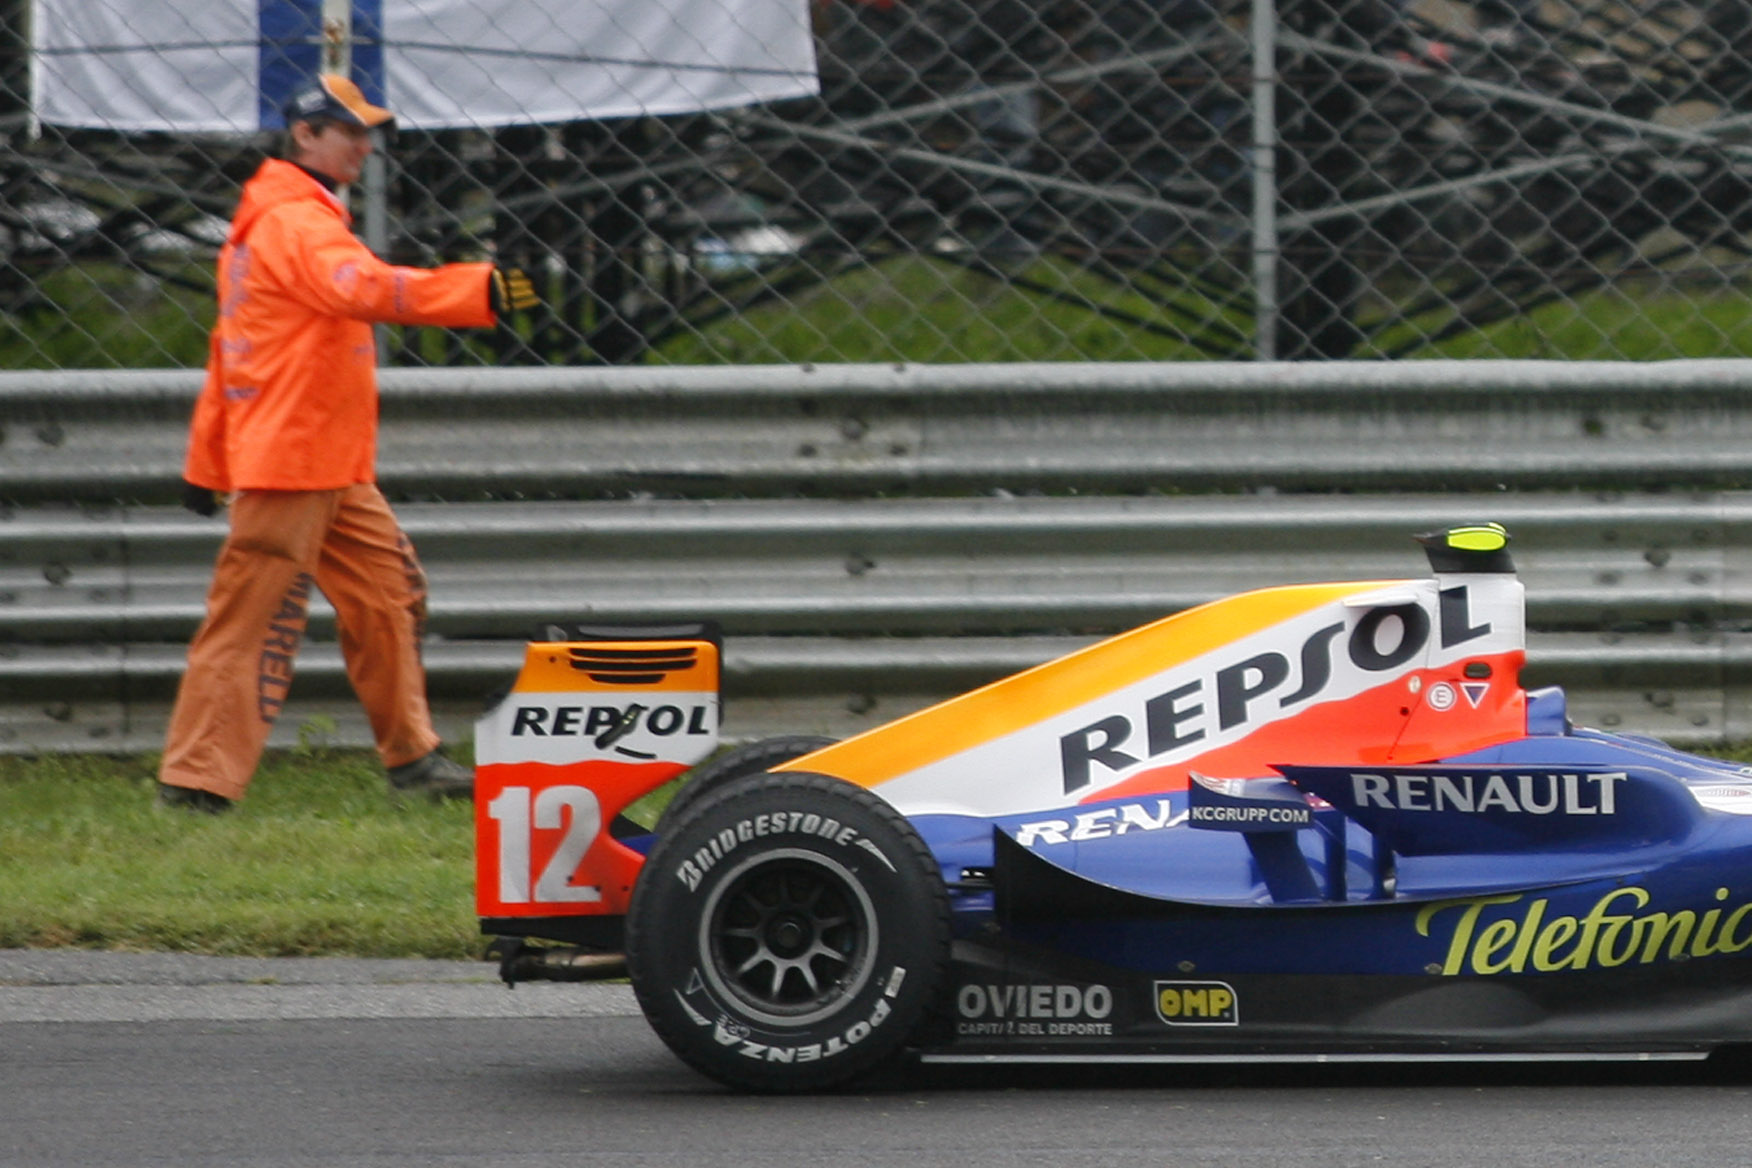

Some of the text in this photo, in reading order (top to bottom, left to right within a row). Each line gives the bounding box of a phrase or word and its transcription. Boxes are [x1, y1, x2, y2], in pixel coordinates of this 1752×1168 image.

[1060, 585, 1492, 795] REPSOL
[1350, 772, 1627, 815] RENAULT
[488, 785, 602, 904] 12
[676, 812, 859, 892] BRIDGESTONE
[958, 985, 1113, 1018] OVIEDO
[1159, 988, 1232, 1017] OMP
[713, 998, 892, 1064] POTENZA
[1018, 1022, 1045, 1036] DEL
[1049, 1022, 1113, 1036] DEPORTE
